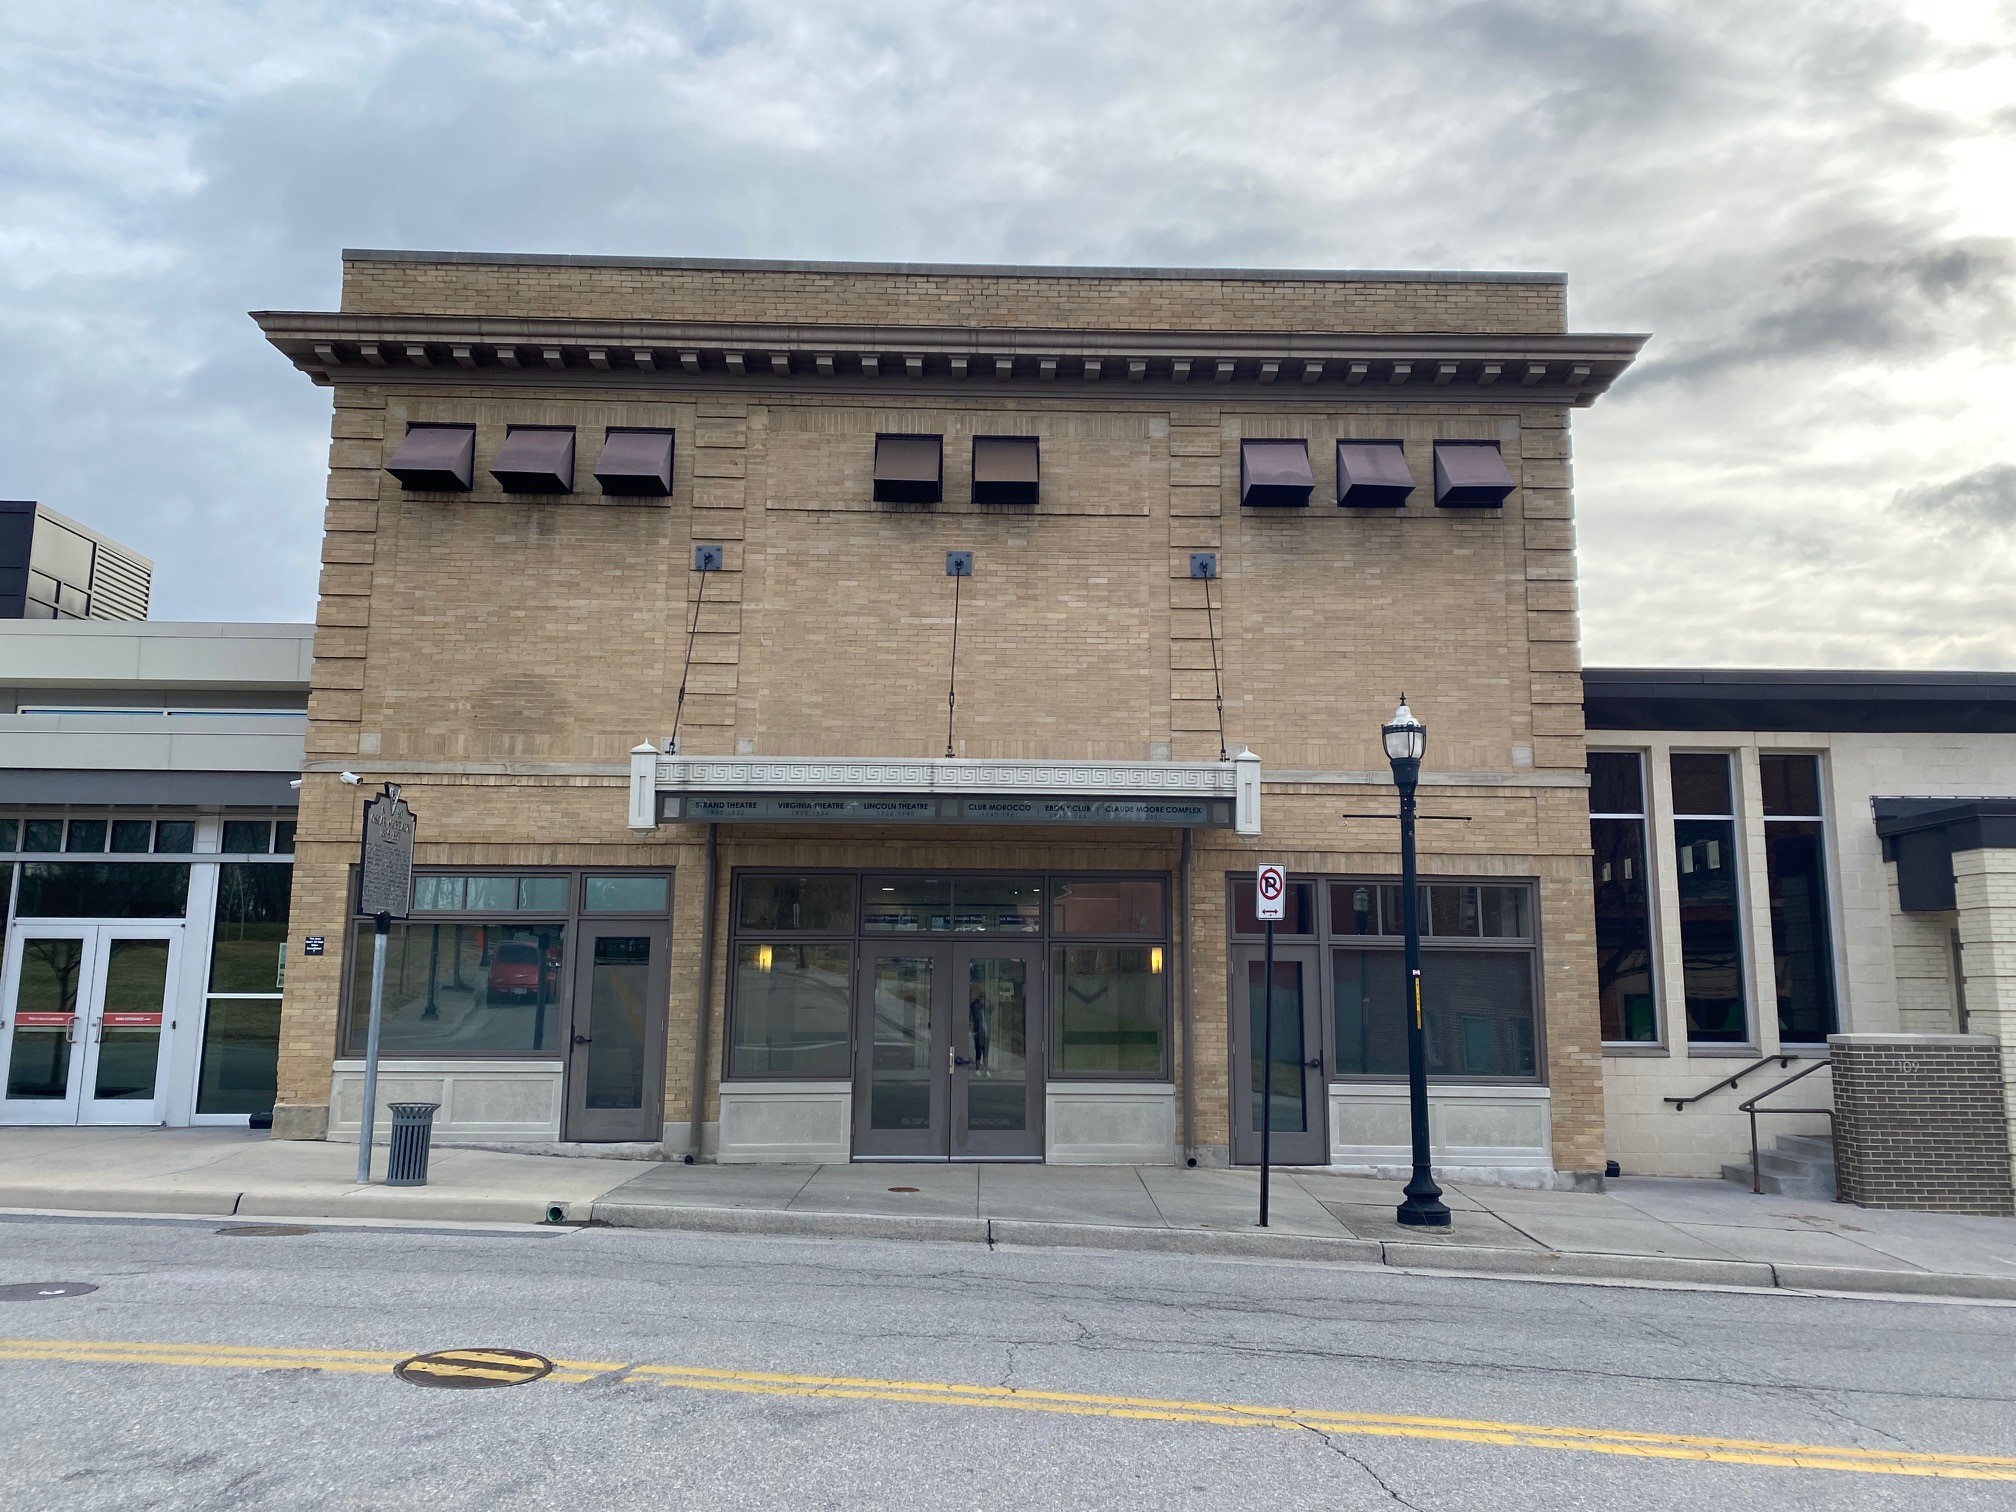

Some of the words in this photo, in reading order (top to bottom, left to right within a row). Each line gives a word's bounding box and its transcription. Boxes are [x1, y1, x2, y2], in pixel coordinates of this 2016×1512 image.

[695, 801, 724, 809] STRAND
[726, 801, 758, 809] THEATRE
[777, 802, 812, 810] VIRGINIA
[814, 802, 844, 810] THEATRE
[968, 803, 987, 811] CLUB
[988, 804, 1032, 812] MOROCCO
[1104, 805, 1134, 813] CLAUDE
[1165, 806, 1202, 814] COMPLEX
[1898, 1061, 1920, 1073] 109
